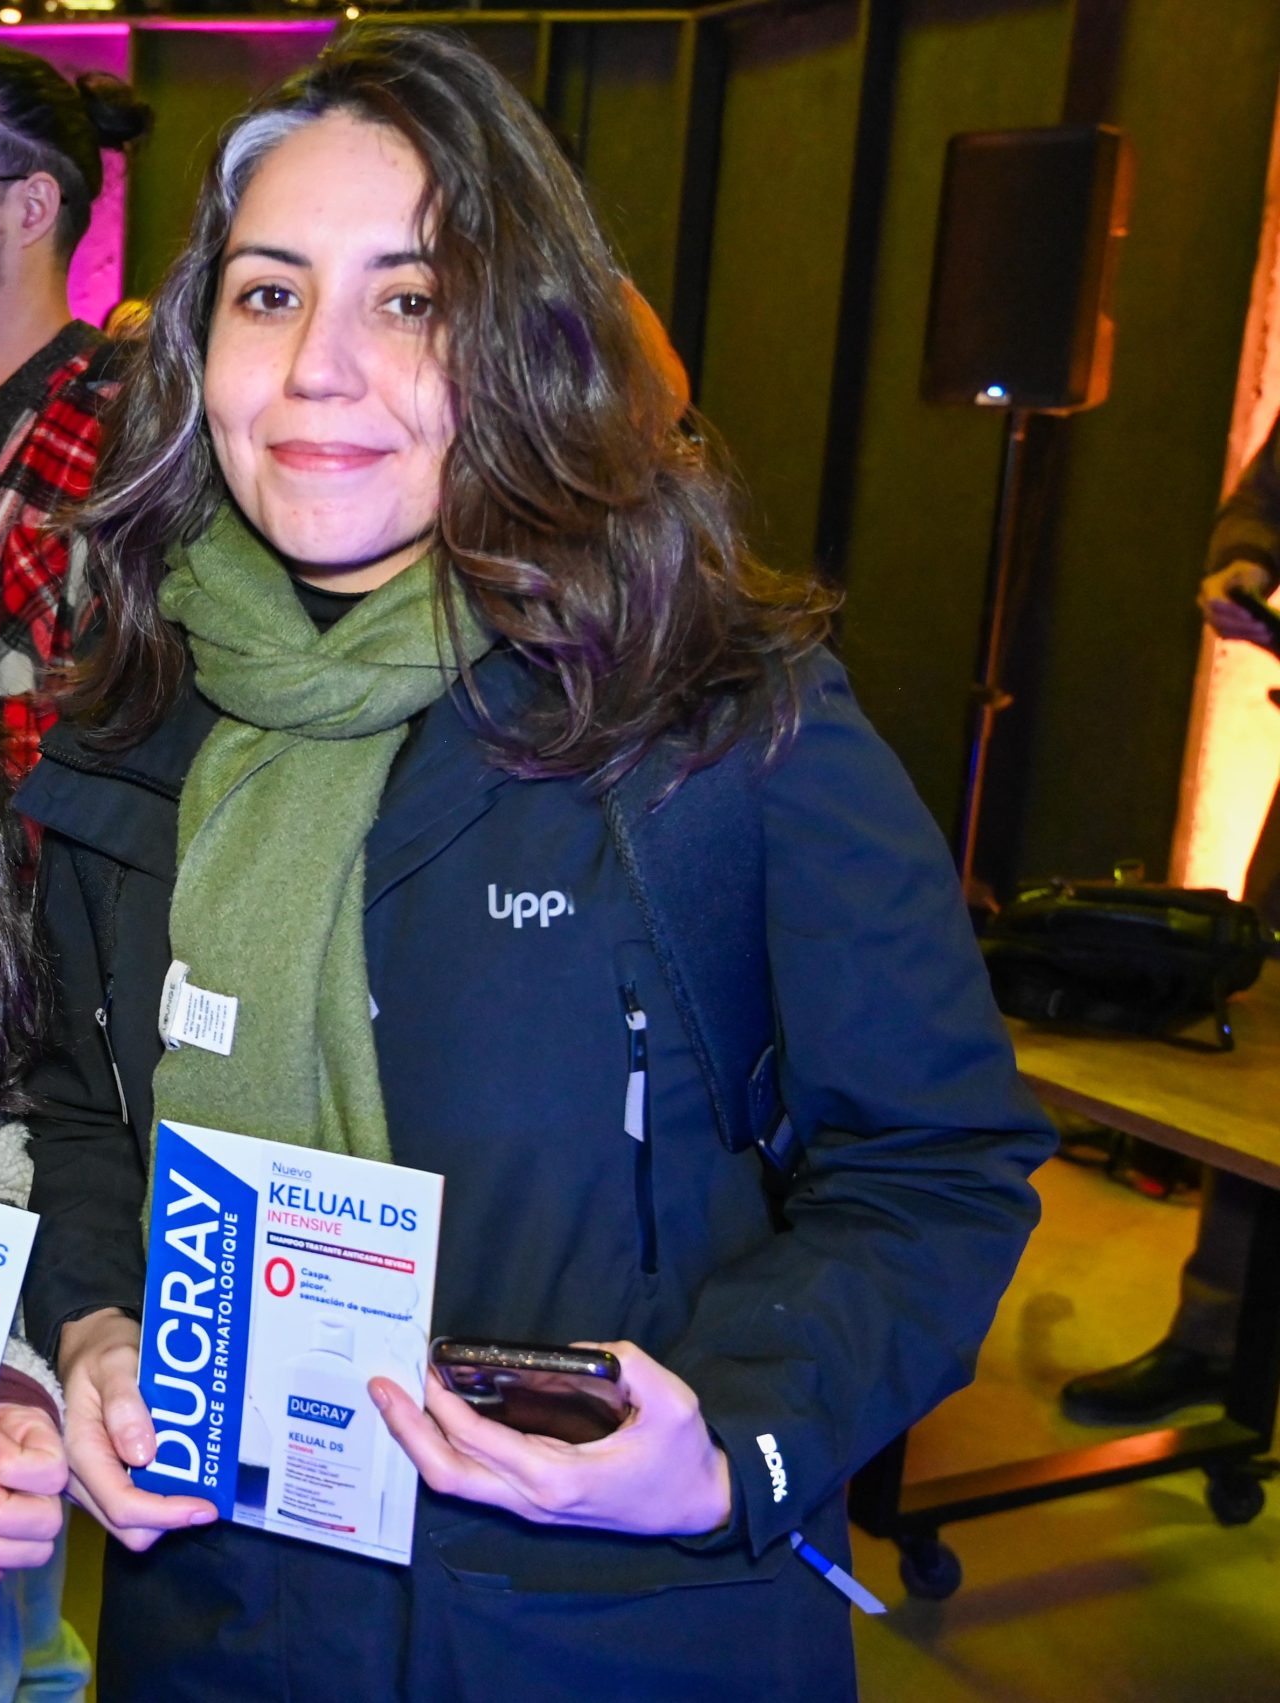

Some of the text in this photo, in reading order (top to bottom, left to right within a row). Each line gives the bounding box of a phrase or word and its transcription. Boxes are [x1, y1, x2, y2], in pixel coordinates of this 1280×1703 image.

[272, 1161, 312, 1179] Nuevo
[269, 1181, 418, 1232] KELUAL DS
[267, 1209, 343, 1236] INTENSIVE
[299, 1279, 327, 1293] picor,
[300, 1267, 332, 1283] Caspa,
[299, 1292, 345, 1308] sensación
[347, 1301, 359, 1311] de
[145, 1167, 221, 1483] DUCRAY
[203, 1210, 239, 1488] SCIENCE DERMATOLOGIQUE
[290, 1398, 349, 1422] DUCRAY
[288, 1431, 345, 1453] KELUAL DS
